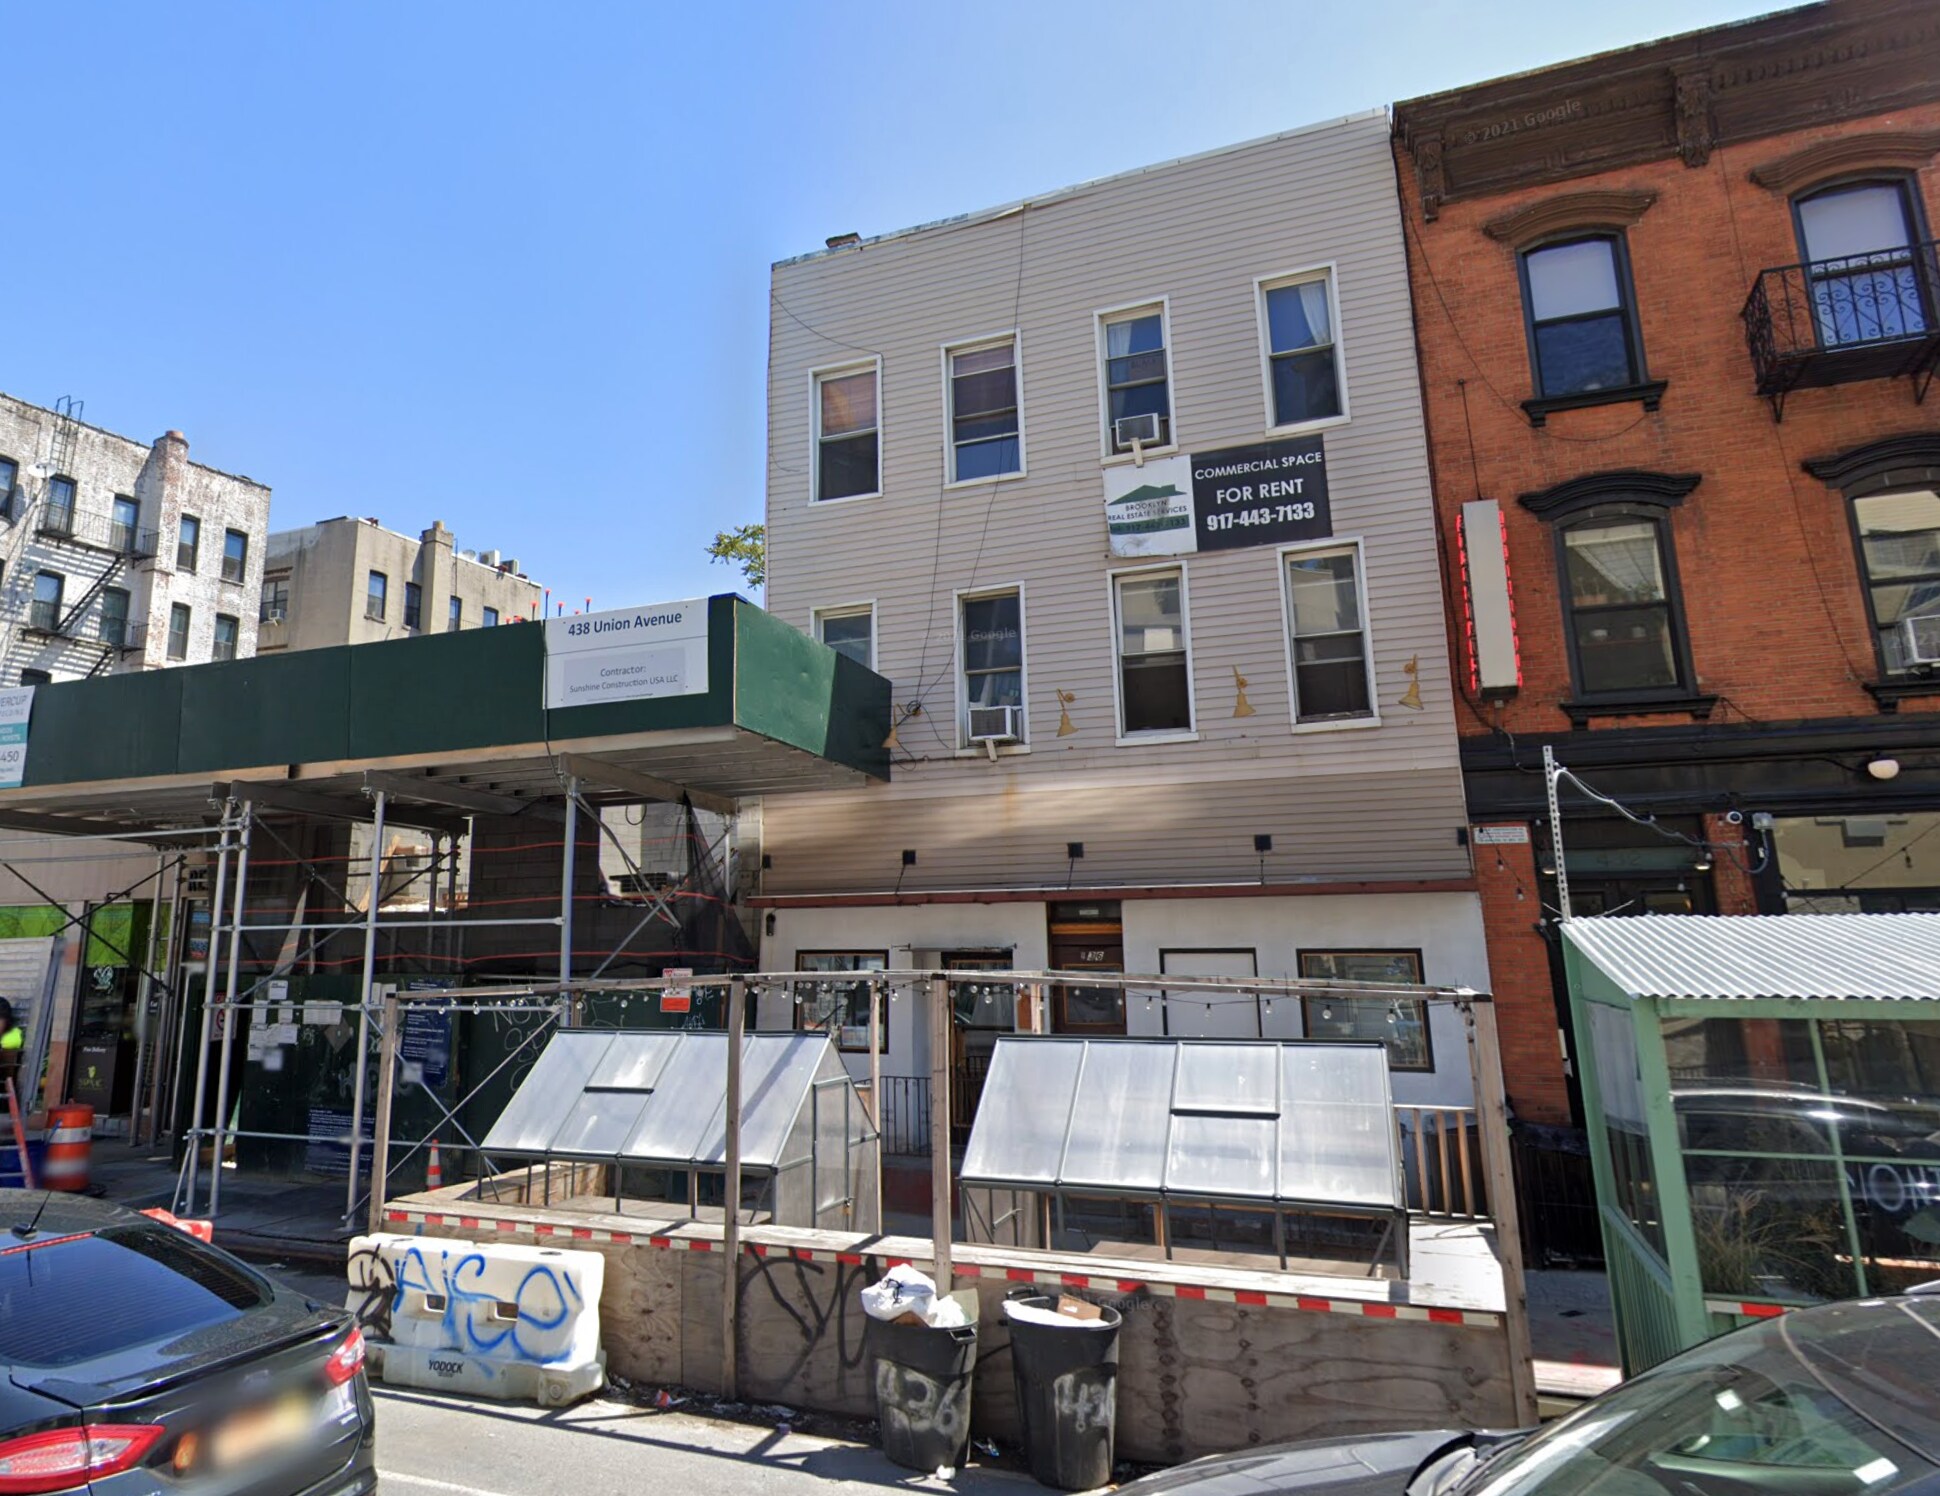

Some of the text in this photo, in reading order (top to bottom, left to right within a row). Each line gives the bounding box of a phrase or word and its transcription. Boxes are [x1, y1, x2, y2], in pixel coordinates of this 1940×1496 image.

[1195, 452, 1322, 480] COMMERCIAL SPACE
[1216, 478, 1304, 504] FOR RENT
[1125, 499, 1167, 511] BROOKLYN
[1127, 511, 1150, 520] ESTATE
[1206, 502, 1315, 531] 917-443-7133
[568, 612, 683, 636] 438 Union Avenue
[600, 665, 647, 677] Contractor:
[569, 674, 679, 693] Sunshine Construction USA LLC
[428, 1360, 465, 1374] YODOCK
